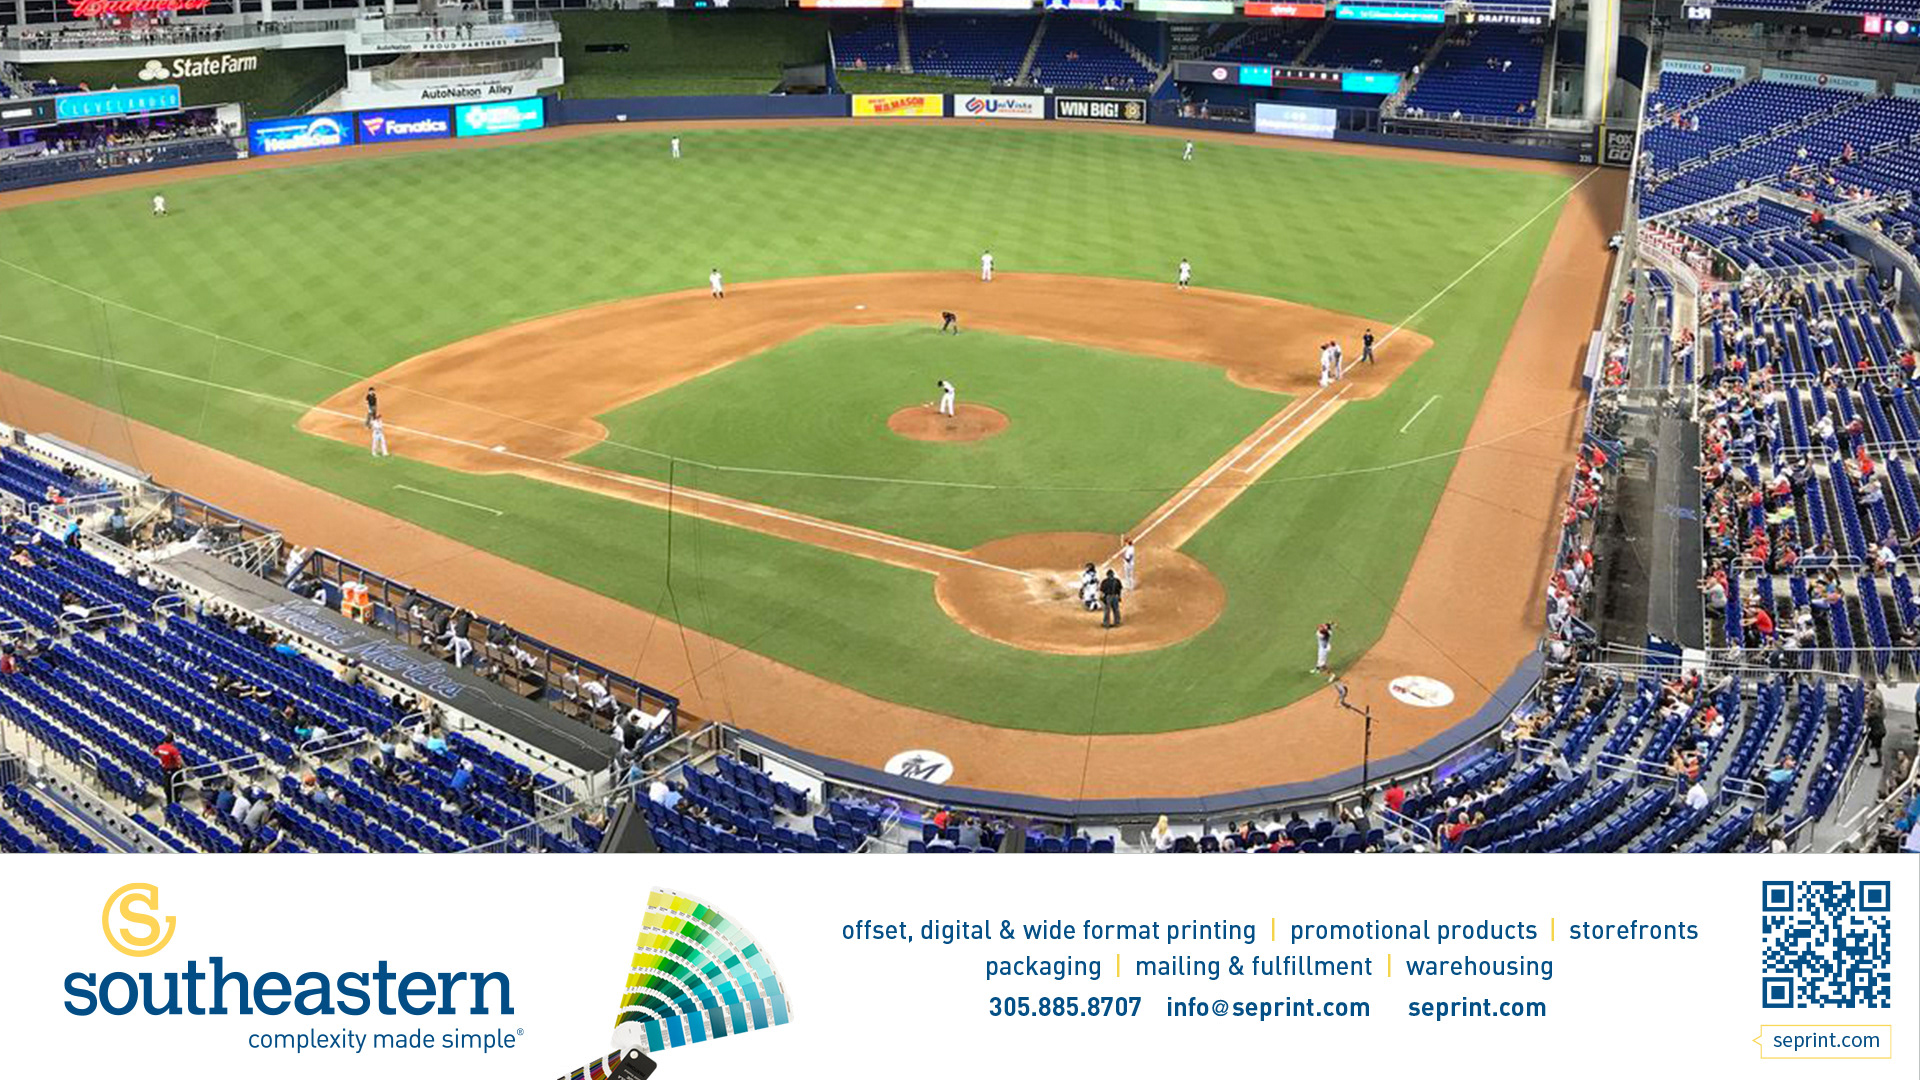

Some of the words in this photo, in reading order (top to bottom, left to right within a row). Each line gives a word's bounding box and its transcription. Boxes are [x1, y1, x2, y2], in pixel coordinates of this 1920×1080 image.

[1478, 14, 1542, 25] DRAFTKINGS
[421, 88, 482, 100] AutoNation
[488, 84, 514, 95] Alley
[1060, 101, 1089, 116] WIN
[1091, 102, 1119, 118] BIG!
[385, 119, 447, 135] Fanatics
[1607, 133, 1634, 145] FOX
[1607, 149, 1632, 161] GO
